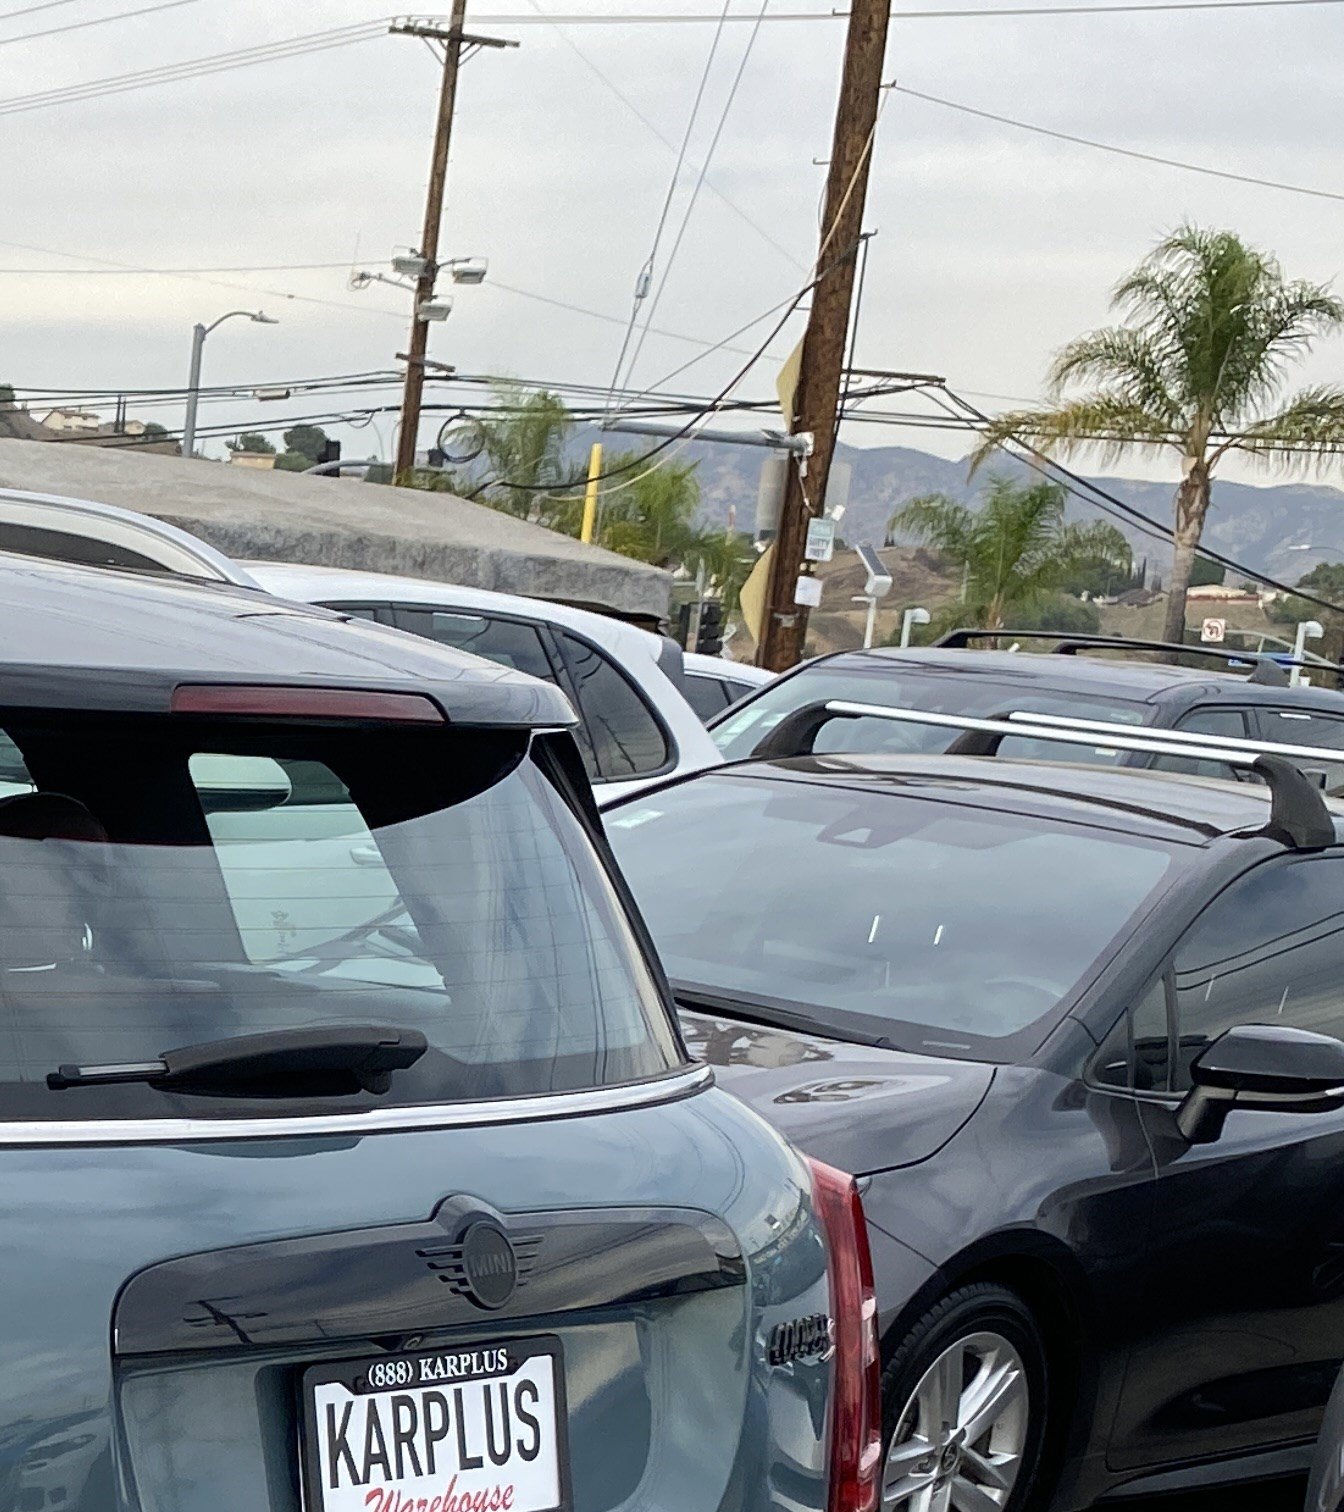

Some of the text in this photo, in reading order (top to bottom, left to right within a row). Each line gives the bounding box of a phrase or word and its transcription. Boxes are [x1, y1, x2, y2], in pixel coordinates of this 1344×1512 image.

[468, 1252, 513, 1277] MINI
[368, 1348, 508, 1388] (888) KARPLUS
[326, 1379, 541, 1489] KARPLUS
